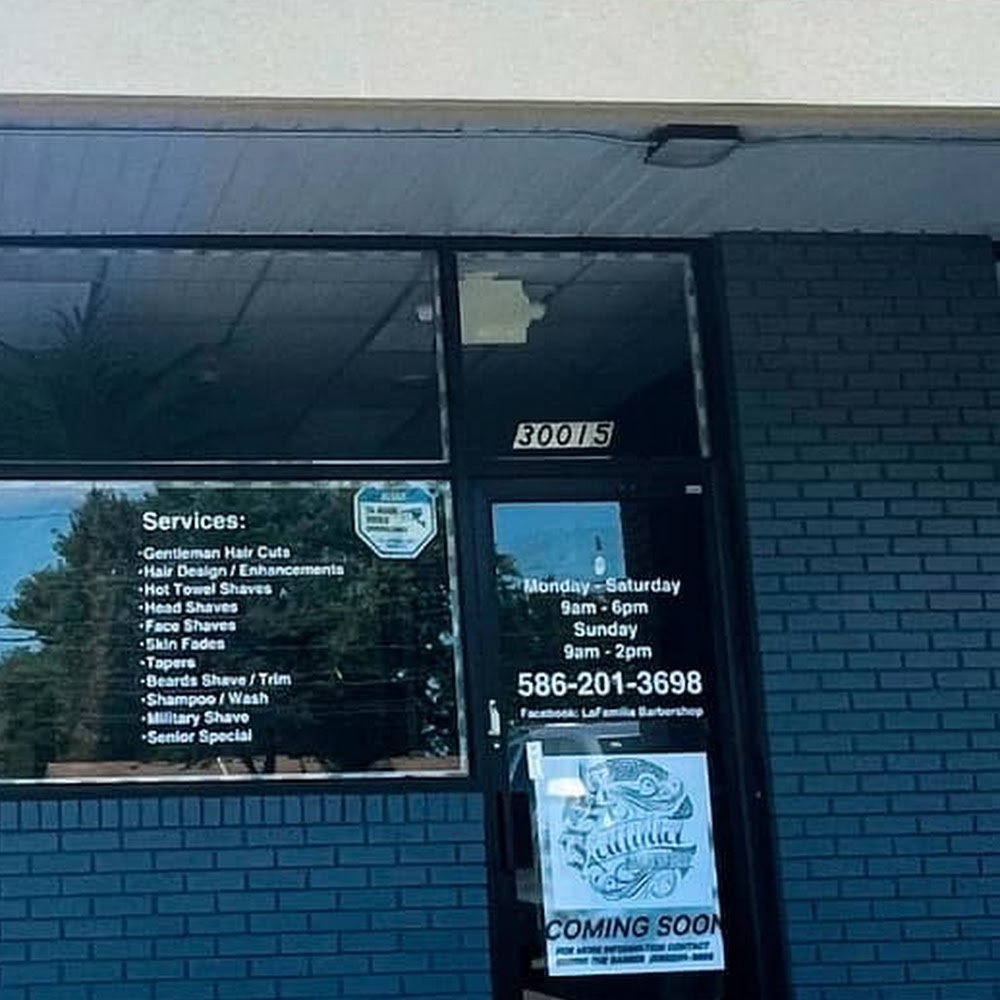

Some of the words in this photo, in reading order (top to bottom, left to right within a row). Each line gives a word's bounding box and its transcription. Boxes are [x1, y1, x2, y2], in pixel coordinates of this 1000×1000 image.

[518, 423, 612, 446] 30015
[142, 511, 246, 531] Services:
[143, 547, 221, 560] Gentleman
[224, 546, 254, 559] Hair
[257, 545, 291, 559] Cuts
[144, 565, 173, 577] Hair
[177, 565, 227, 580] Design
[239, 564, 344, 577] Enhancements
[144, 583, 170, 596] Hot
[173, 583, 216, 596] Towel
[219, 582, 273, 595] Shaves
[524, 578, 590, 596] Monday
[605, 577, 681, 596] Saturday
[144, 602, 182, 614] Head
[185, 601, 238, 613] Shaves
[561, 600, 597, 615] 9am
[611, 600, 649, 617] 6pm
[145, 619, 180, 633] Face
[183, 618, 236, 632] Shaves
[573, 620, 638, 640] Sunday
[145, 638, 178, 650] Skin
[181, 637, 226, 650] Fades
[563, 643, 600, 659] 9am
[614, 643, 652, 661] 2pm
[146, 656, 196, 671] Tapers
[146, 674, 198, 687] Beards
[201, 673, 247, 687] Shave
[258, 672, 292, 685] Trim
[518, 671, 703, 696] 586-201-3698
[146, 693, 217, 707] Shampoo
[228, 691, 269, 705] Wash
[147, 711, 200, 727] Military
[203, 710, 250, 724] Shave
[147, 730, 196, 744] Senior
[199, 729, 252, 745] Special
[547, 916, 650, 940] COMING
